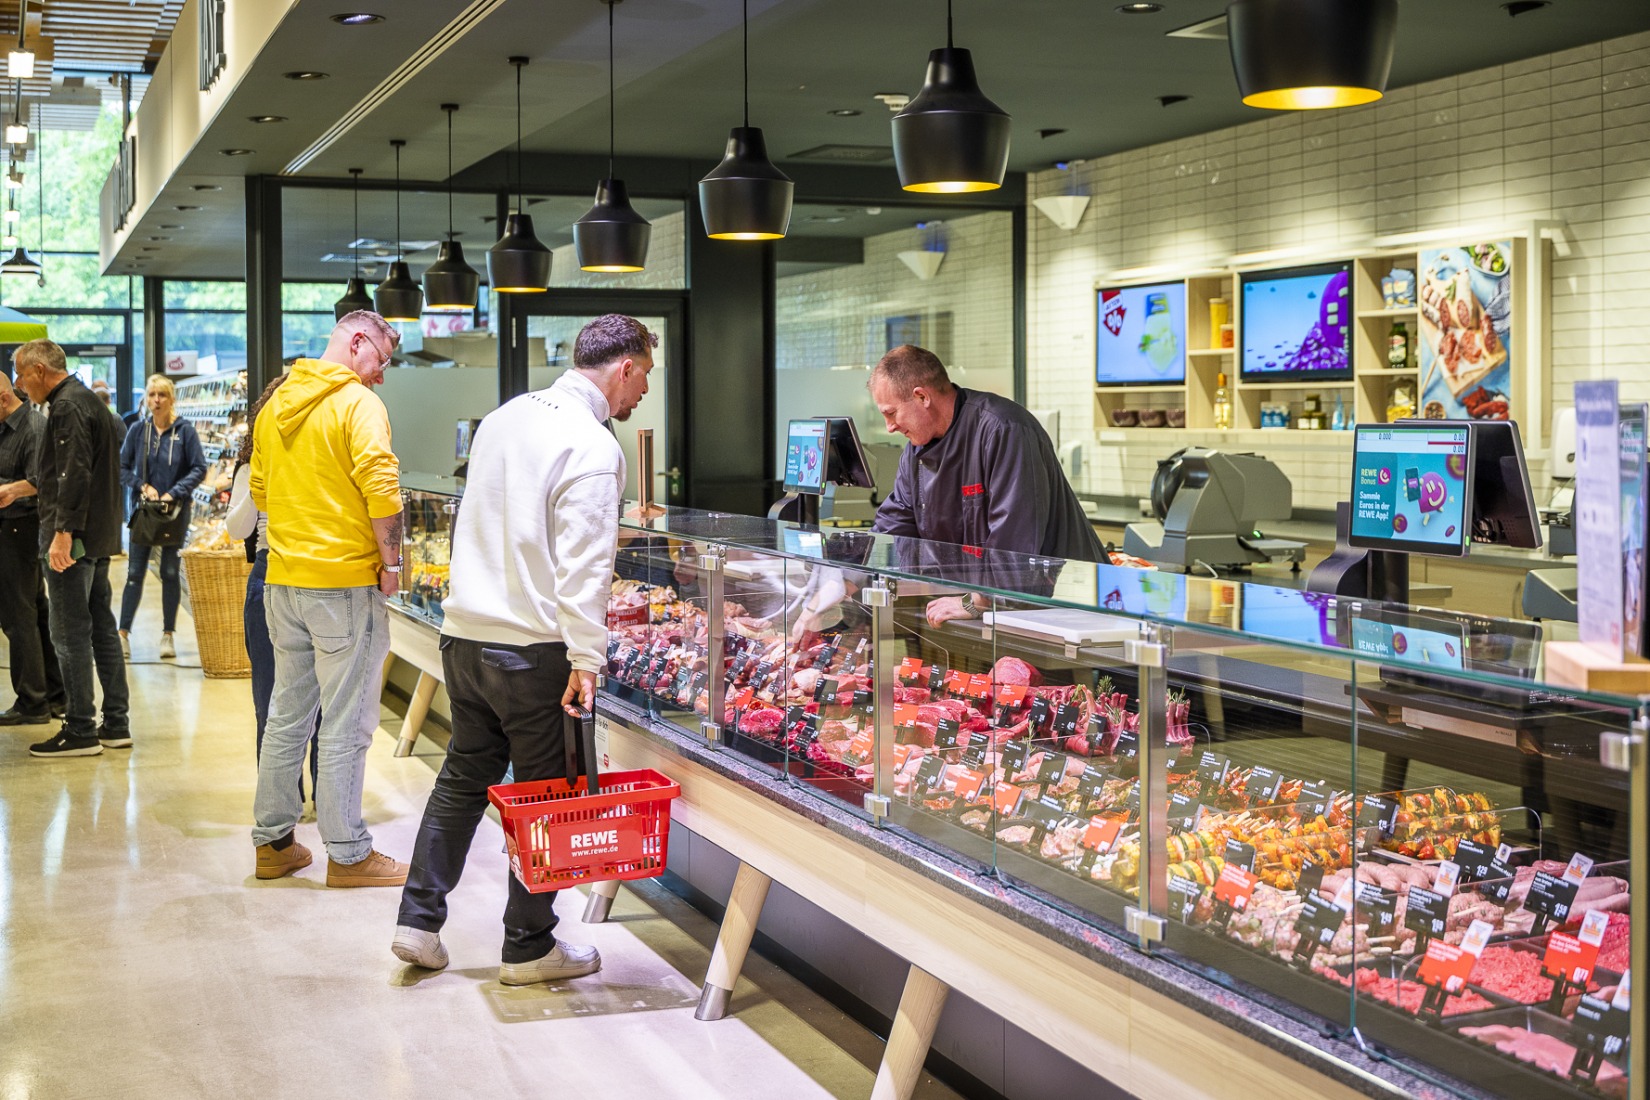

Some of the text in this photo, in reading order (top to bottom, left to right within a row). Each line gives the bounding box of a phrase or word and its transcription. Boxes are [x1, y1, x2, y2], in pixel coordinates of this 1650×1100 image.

[1453, 433, 1465, 441] 0.00
[1452, 445, 1464, 453] 0.00
[1360, 469, 1377, 477] REWE
[1360, 477, 1376, 485] Bonus
[1359, 491, 1380, 500] Sammle
[1359, 501, 1374, 509] Euros
[1381, 502, 1390, 510] der
[1358, 510, 1389, 521] REWE App!
[571, 830, 618, 849] REWE
[572, 845, 618, 858] www.rewe.de
